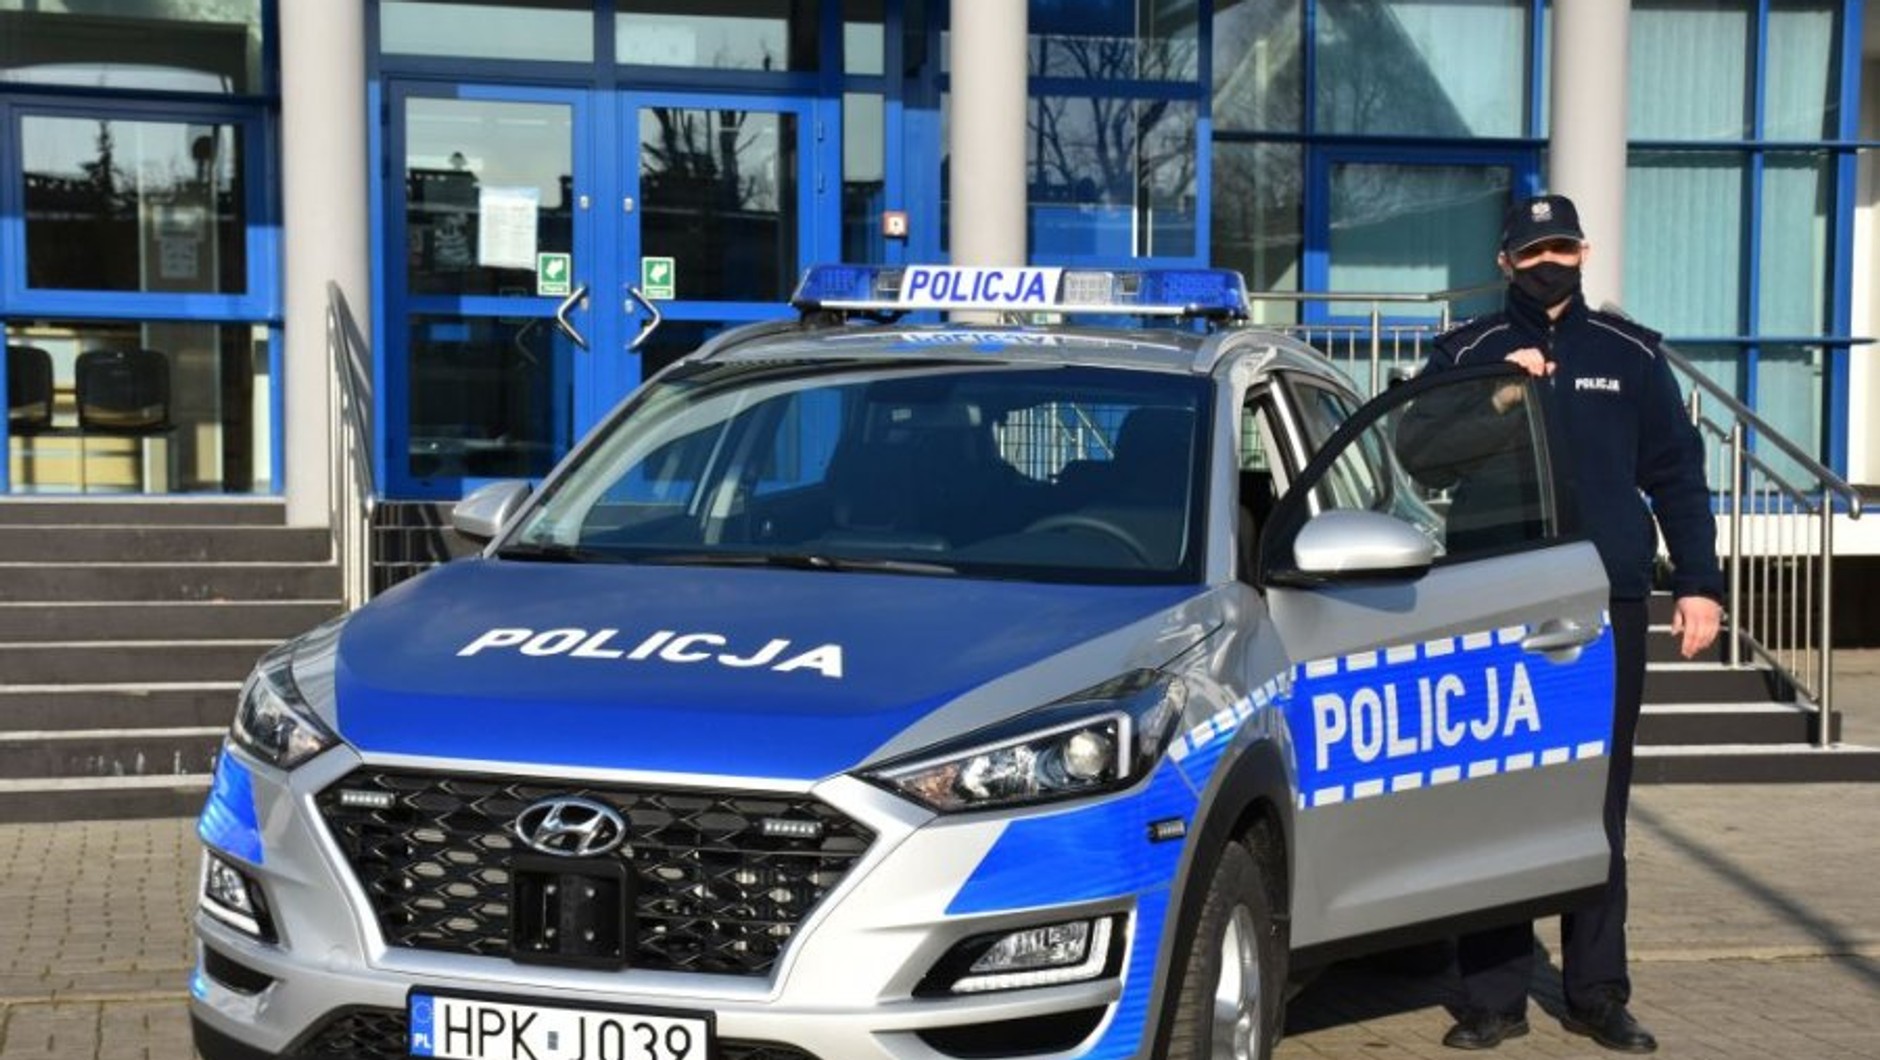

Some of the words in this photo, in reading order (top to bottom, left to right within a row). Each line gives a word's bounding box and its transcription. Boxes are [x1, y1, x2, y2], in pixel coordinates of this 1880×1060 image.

[909, 270, 1045, 302] POLICJA
[1575, 377, 1620, 392] POLICJA
[456, 628, 842, 678] POLICJA
[1312, 662, 1541, 771] POLICJA
[413, 1033, 432, 1049] PL
[446, 1004, 538, 1060] HPK
[569, 1017, 692, 1060] J039
